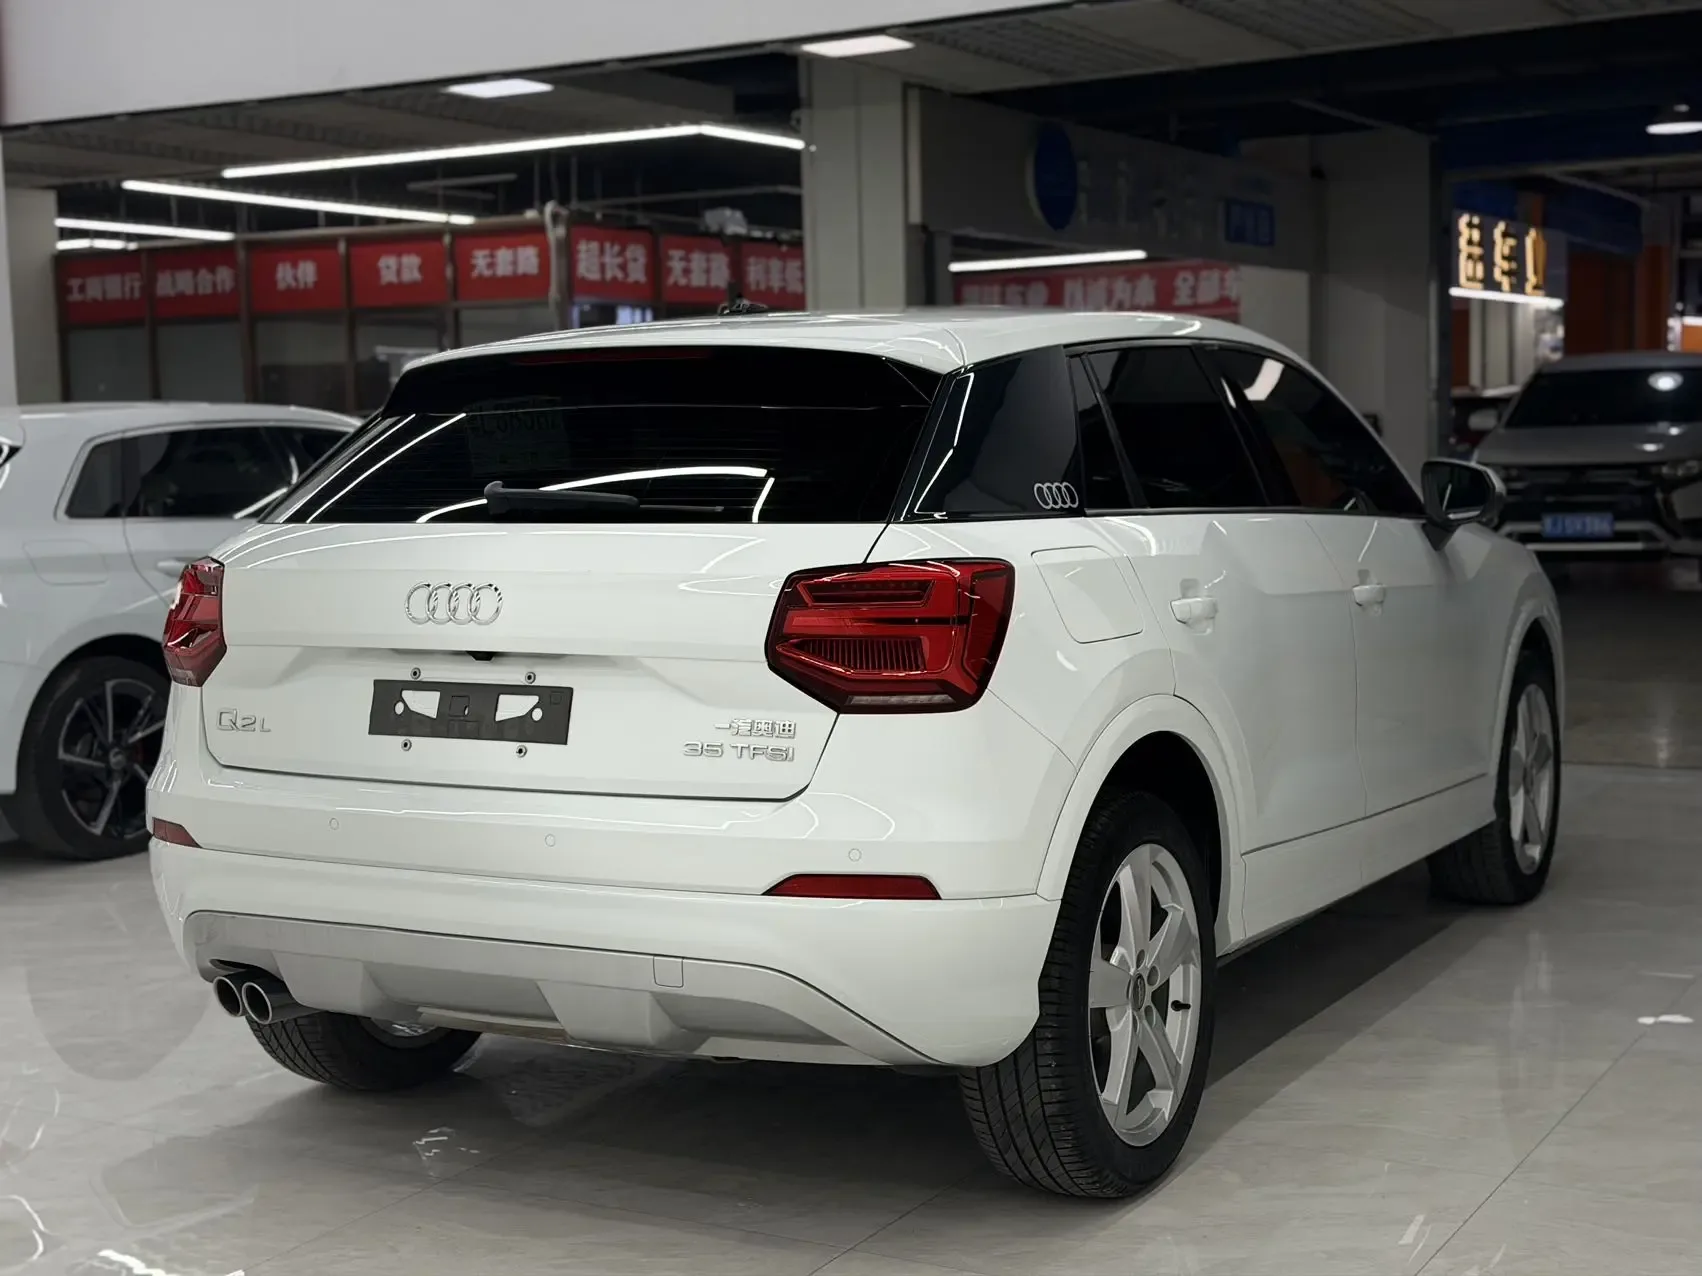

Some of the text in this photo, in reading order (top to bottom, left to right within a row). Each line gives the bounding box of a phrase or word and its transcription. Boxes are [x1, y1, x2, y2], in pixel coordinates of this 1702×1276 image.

[471, 246, 540, 277] 无套路
[667, 249, 730, 289] 无套路
[216, 707, 272, 732] Q2L
[714, 718, 797, 739] 一汽奥迪
[683, 741, 795, 762] 35 TFSI
